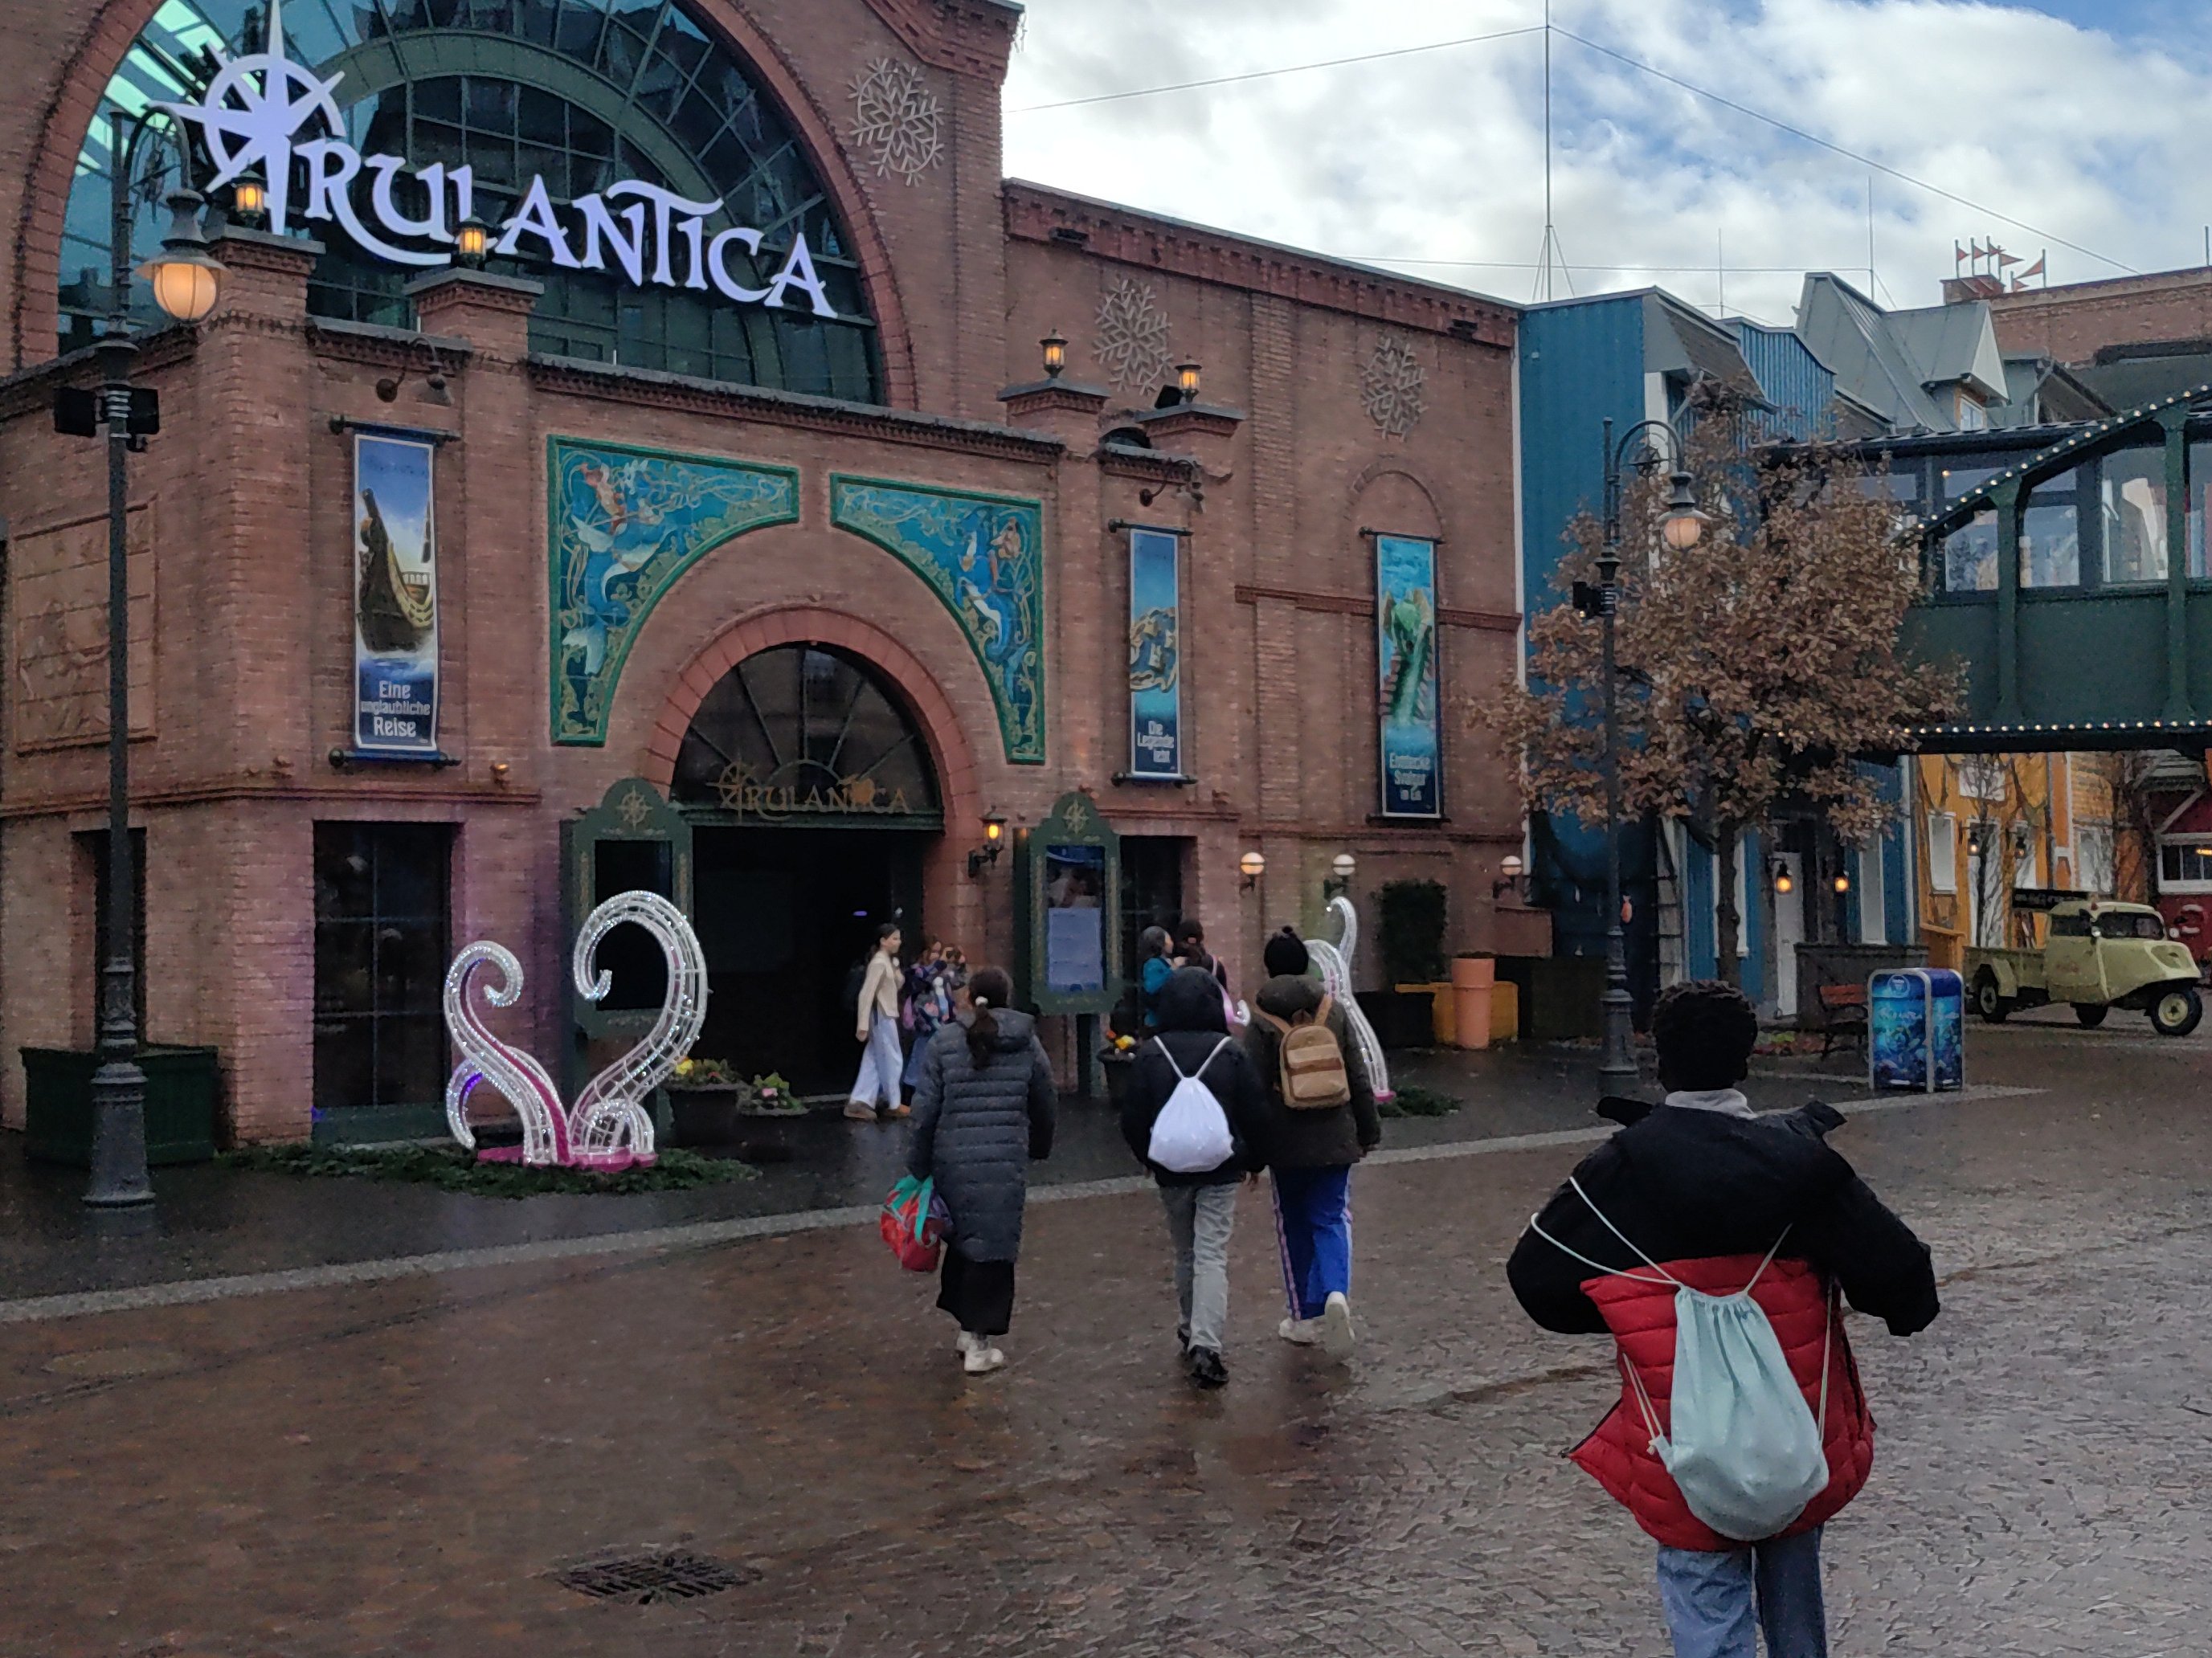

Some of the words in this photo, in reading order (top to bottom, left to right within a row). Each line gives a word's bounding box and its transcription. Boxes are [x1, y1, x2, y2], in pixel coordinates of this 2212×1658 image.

[294, 137, 838, 319] RULANTICA
[378, 680, 411, 699] Eine
[361, 700, 430, 715] glaubliche
[374, 716, 416, 737] Reise
[744, 774, 912, 820] RULANTCA
